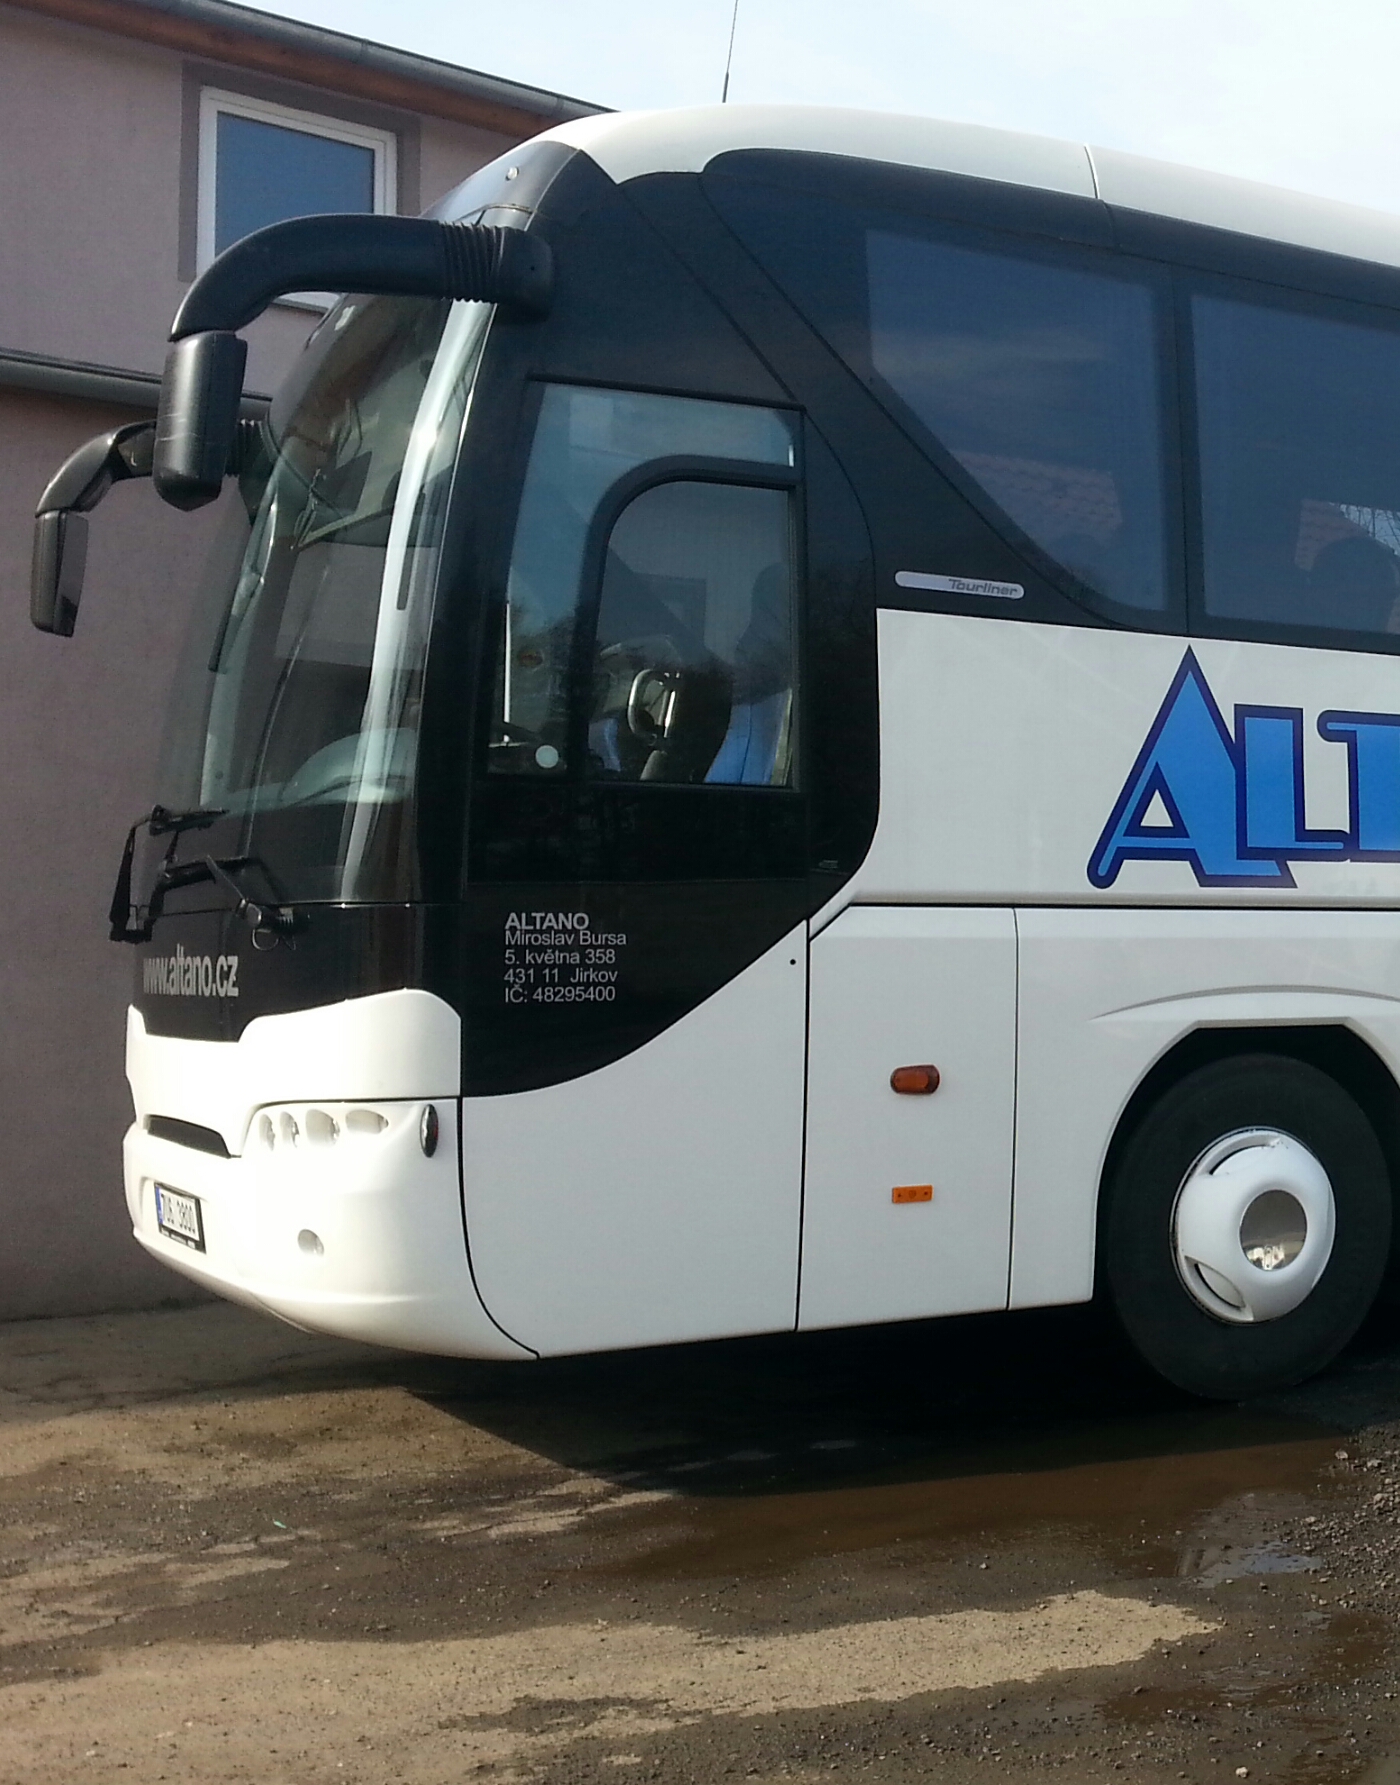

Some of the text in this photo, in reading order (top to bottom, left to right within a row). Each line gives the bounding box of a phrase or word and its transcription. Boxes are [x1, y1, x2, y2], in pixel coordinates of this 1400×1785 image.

[948, 578, 1018, 596] Tourliner
[504, 912, 590, 930] ALTANO
[505, 930, 627, 946] Miroslav Bursa
[505, 948, 616, 965] 5. května 358
[143, 943, 239, 997] www.altano.cz
[503, 967, 618, 984] 431 11 Jirkov
[505, 984, 616, 1003] IČ: 48295400
